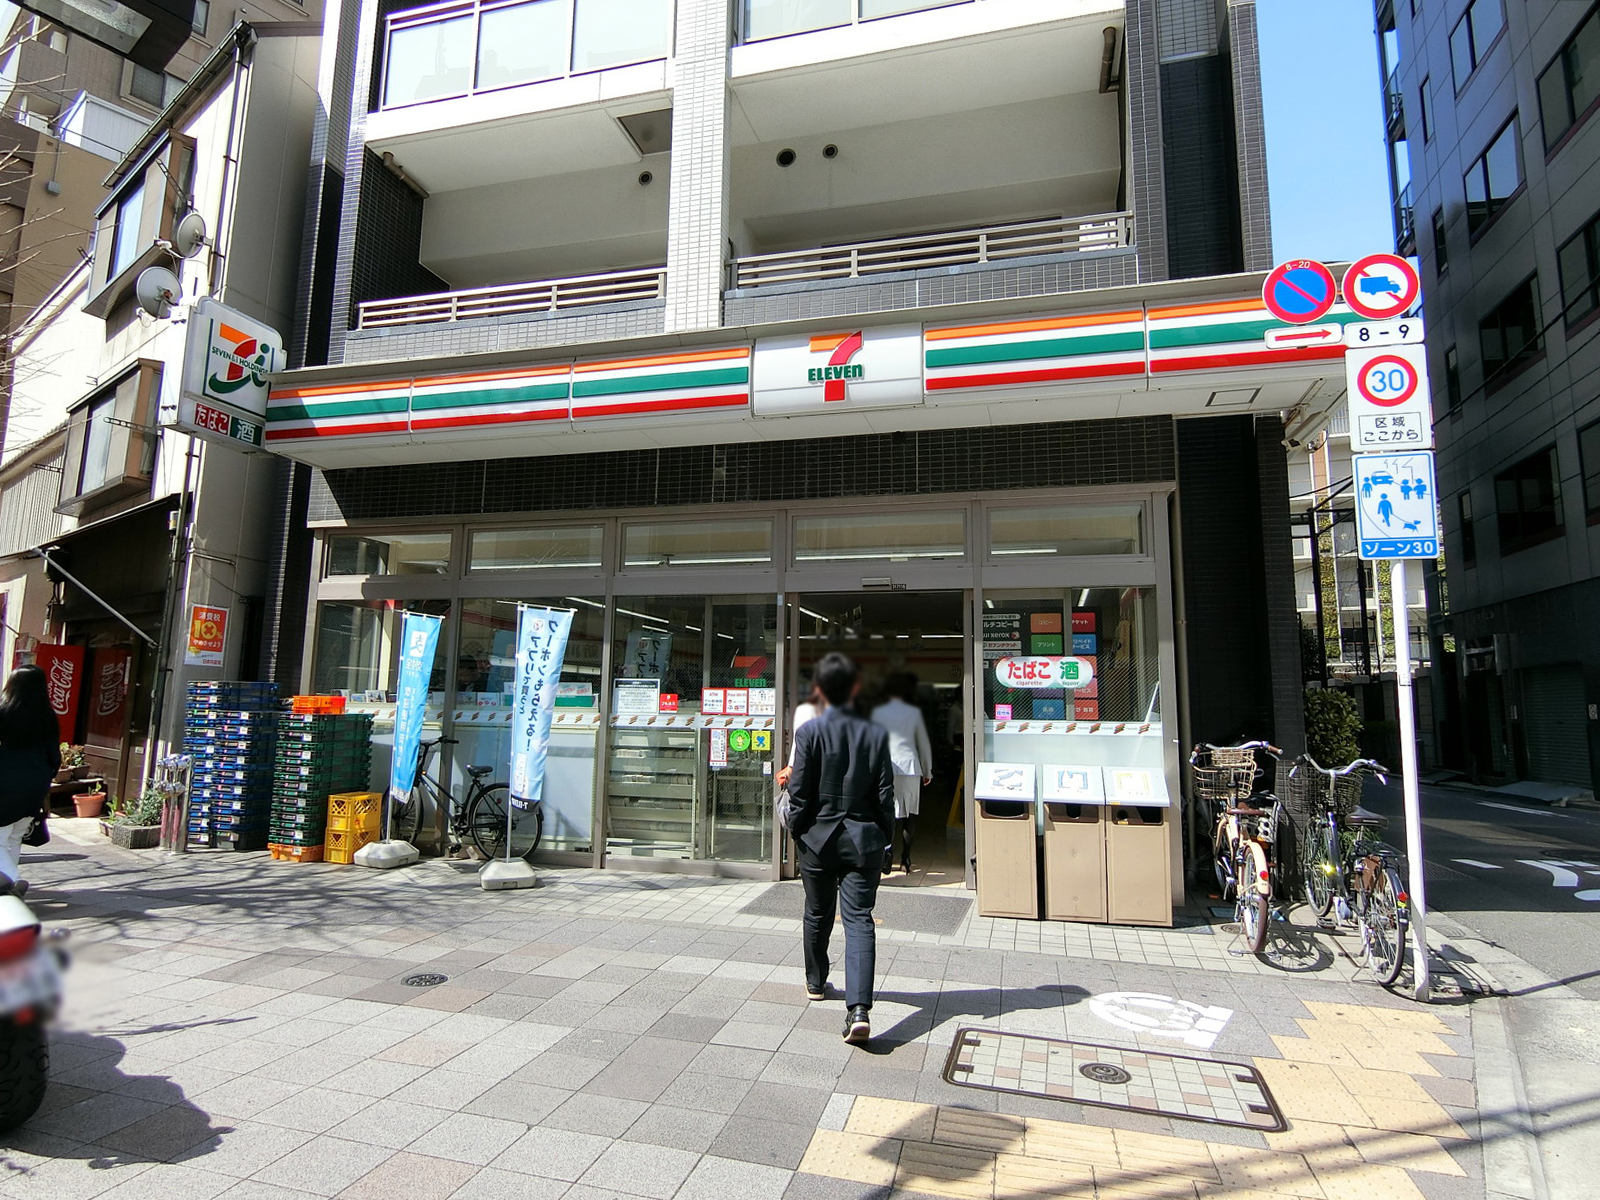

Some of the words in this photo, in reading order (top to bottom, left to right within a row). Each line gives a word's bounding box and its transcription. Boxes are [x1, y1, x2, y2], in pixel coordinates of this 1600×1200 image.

[1286, 261, 1311, 271] 8-20
[1371, 369, 1405, 392] 30
[195, 405, 228, 434] たばこ
[236, 420, 256, 443] 酒
[1375, 416, 1406, 429] 区域
[1364, 429, 1419, 442] ここから
[1365, 541, 1434, 556] ゾーン30
[193, 640, 222, 648] やめさせよう
[1007, 660, 1051, 680] たばこ
[1059, 661, 1080, 680] 酒
